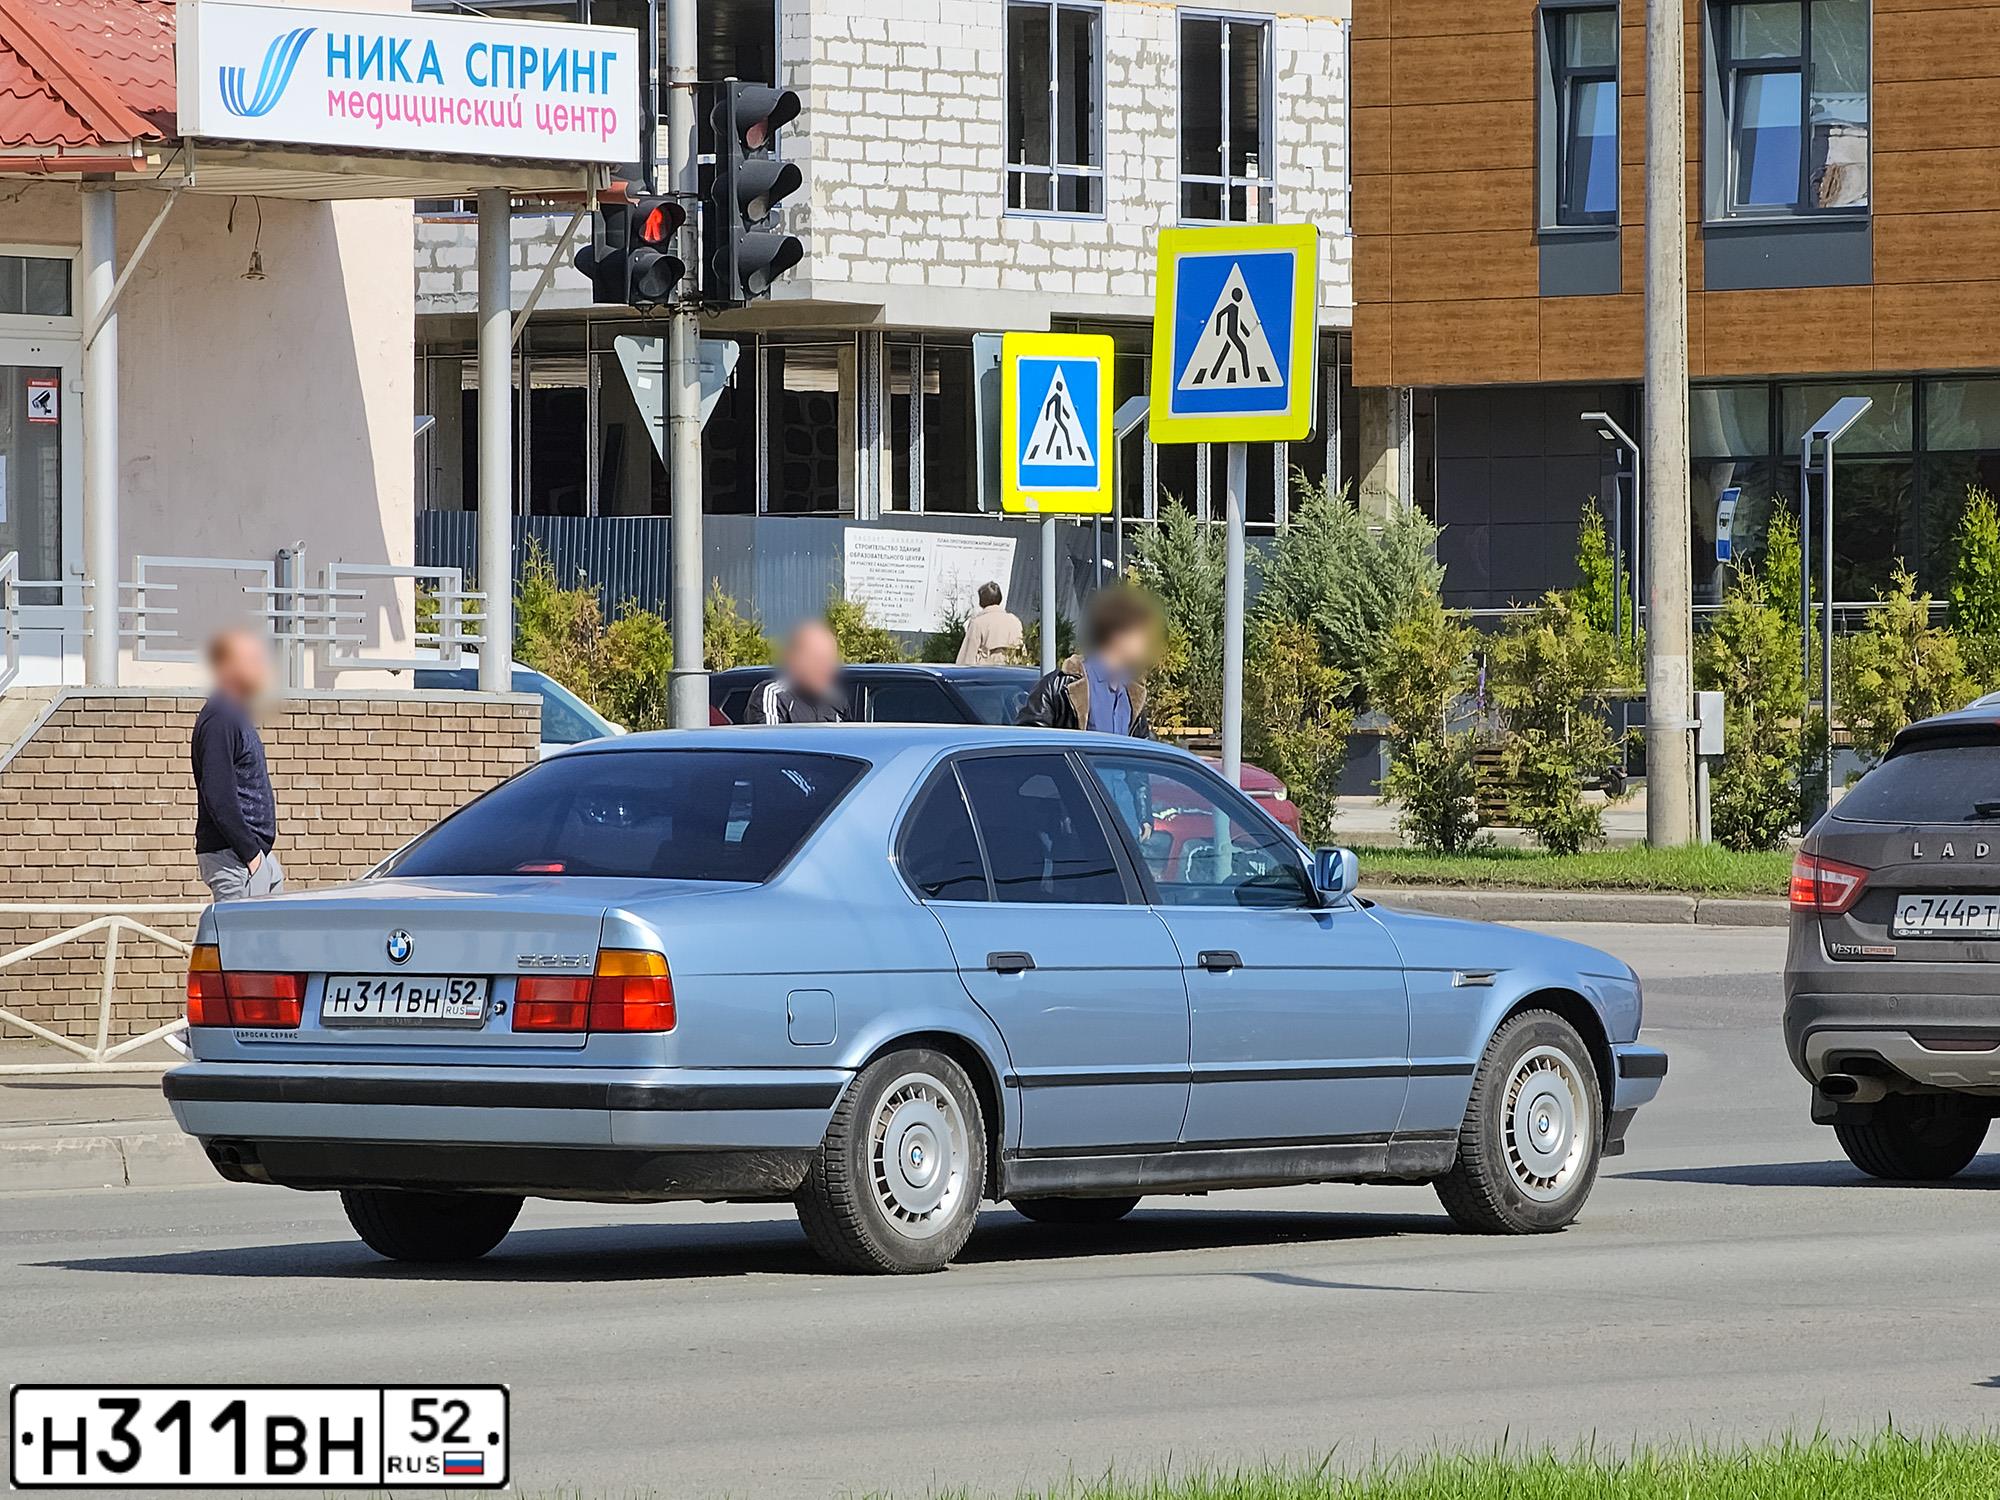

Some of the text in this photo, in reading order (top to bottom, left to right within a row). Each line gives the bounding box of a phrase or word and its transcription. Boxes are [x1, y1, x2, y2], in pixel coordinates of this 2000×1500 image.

[327, 33, 618, 95] НИКА СПРИНГ
[327, 89, 618, 143] медицинский центр
[849, 551, 904, 560] ОБРАЗОВАТЕЛЬНОГО
[854, 543, 899, 552] СТРОИТЕЛЬСТВО
[1903, 898, 1997, 926] С744РТ
[1831, 943, 1862, 955] VESTA
[334, 980, 442, 1013] Н311ВН
[448, 980, 477, 1005] 52
[445, 1006, 465, 1015] RUS
[270, 1031, 298, 1039] СЕРВИС
